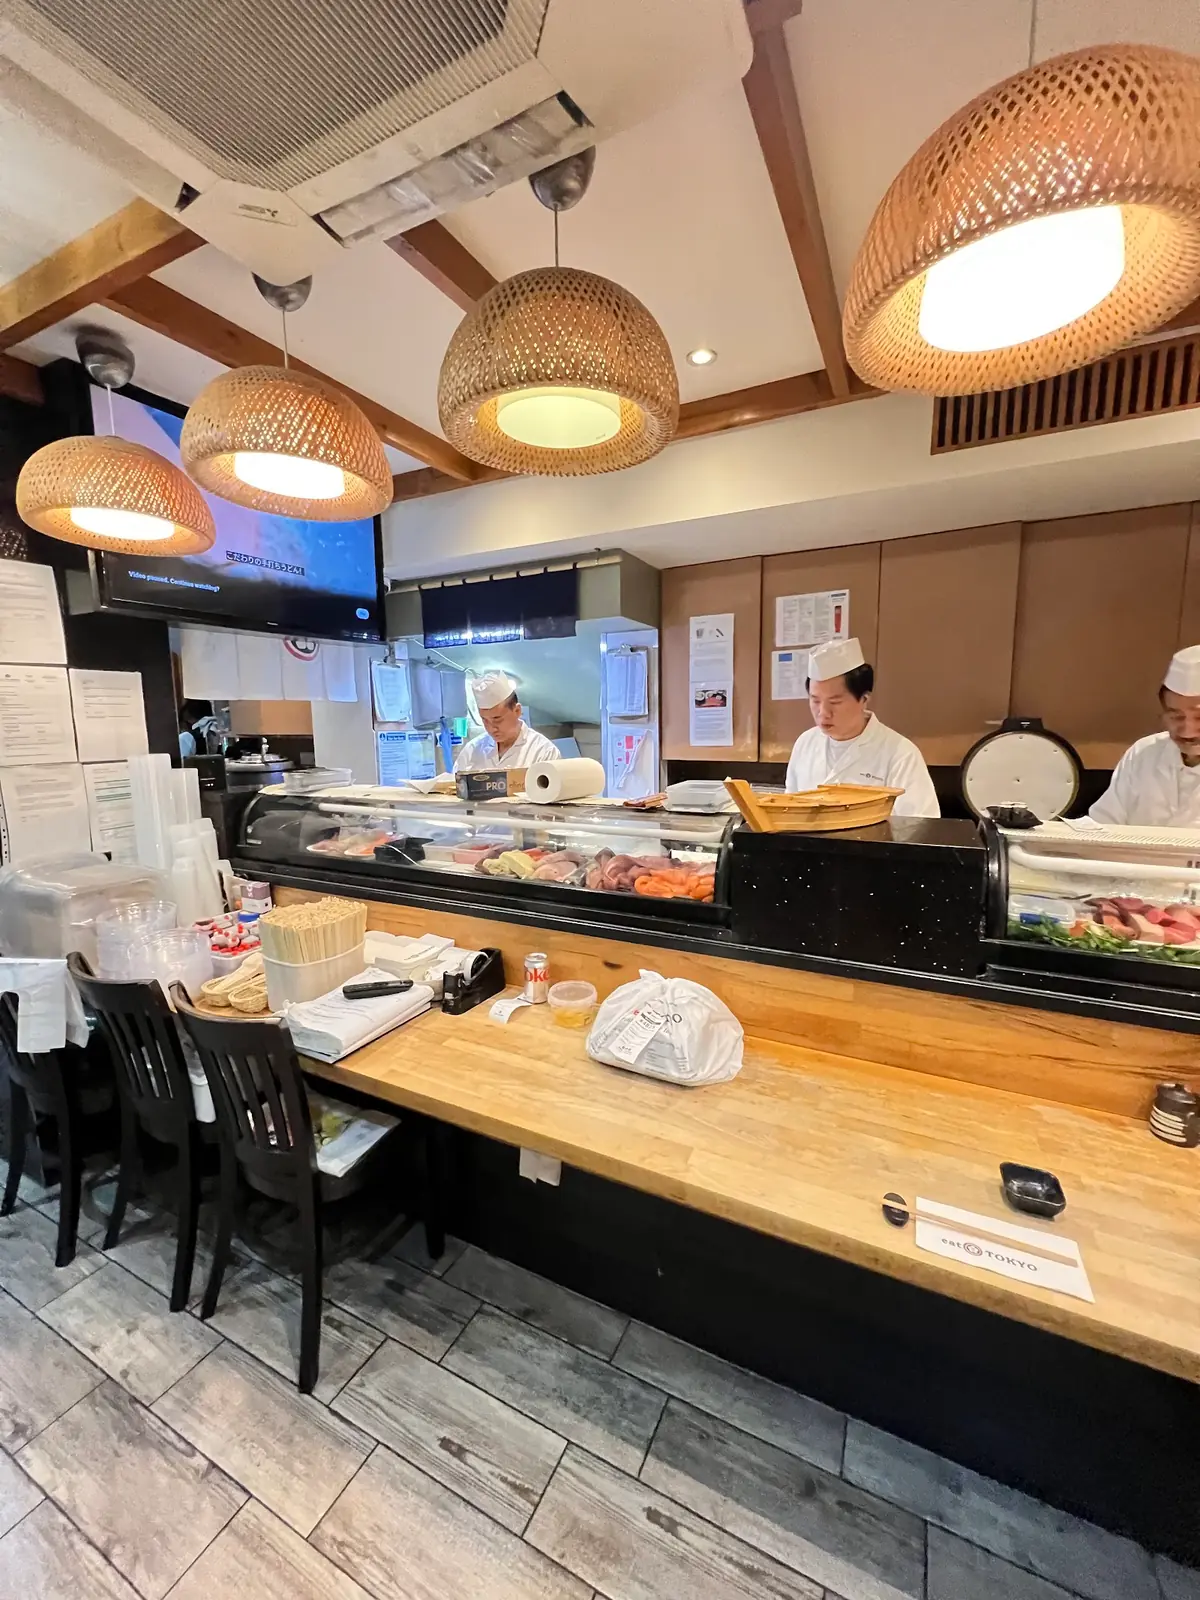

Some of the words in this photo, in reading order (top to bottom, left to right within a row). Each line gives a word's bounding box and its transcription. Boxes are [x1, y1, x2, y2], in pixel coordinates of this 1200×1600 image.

[128, 570, 146, 580] Video
[170, 578, 194, 588] Continue
[195, 583, 219, 593] watching?
[486, 781, 506, 791] PRO
[941, 1238, 962, 1249] eat
[985, 1250, 1038, 1272] TOKYO
